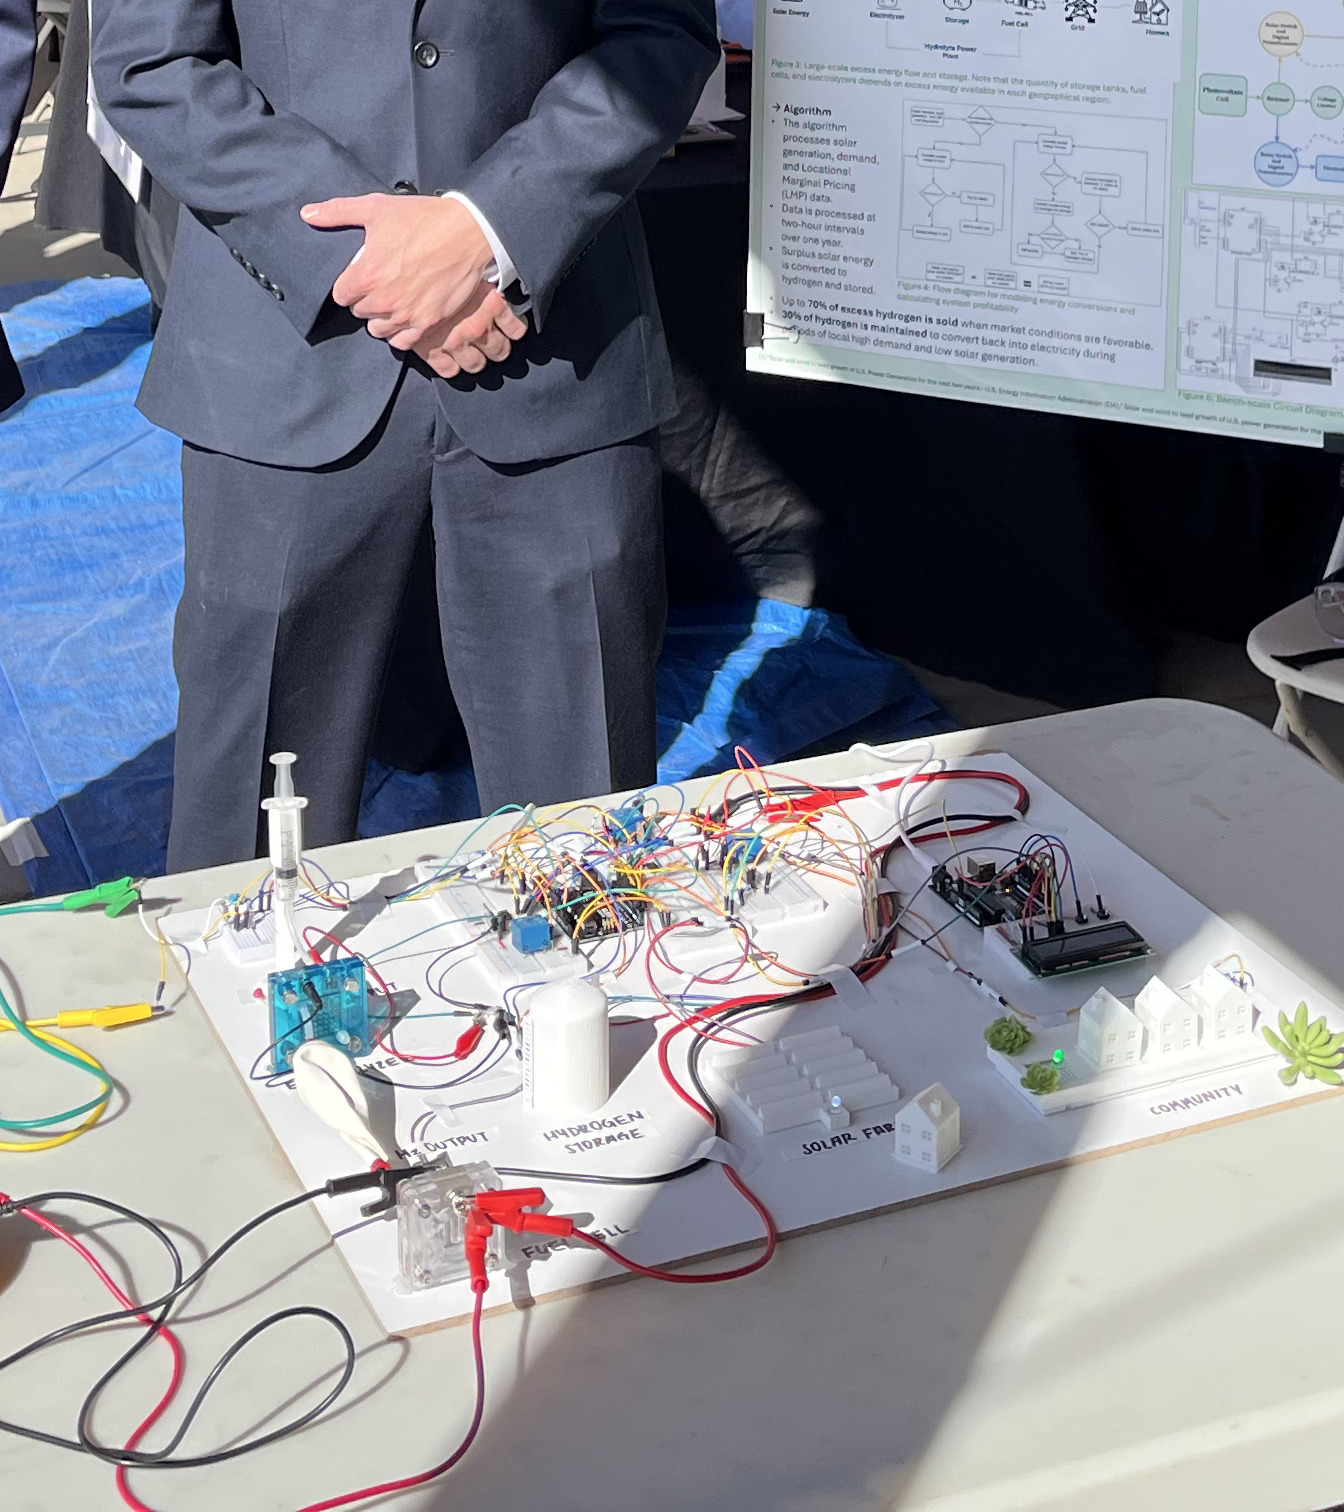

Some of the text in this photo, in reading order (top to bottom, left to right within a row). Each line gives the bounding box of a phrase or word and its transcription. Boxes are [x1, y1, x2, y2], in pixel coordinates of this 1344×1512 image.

[1149, 1082, 1244, 1117] COMMUNITY
[544, 1109, 645, 1142] HYDROGEN
[563, 1128, 644, 1155] STORAGE
[802, 1123, 895, 1155] SOLAR FAR
[423, 1131, 489, 1153] OUTPUT
